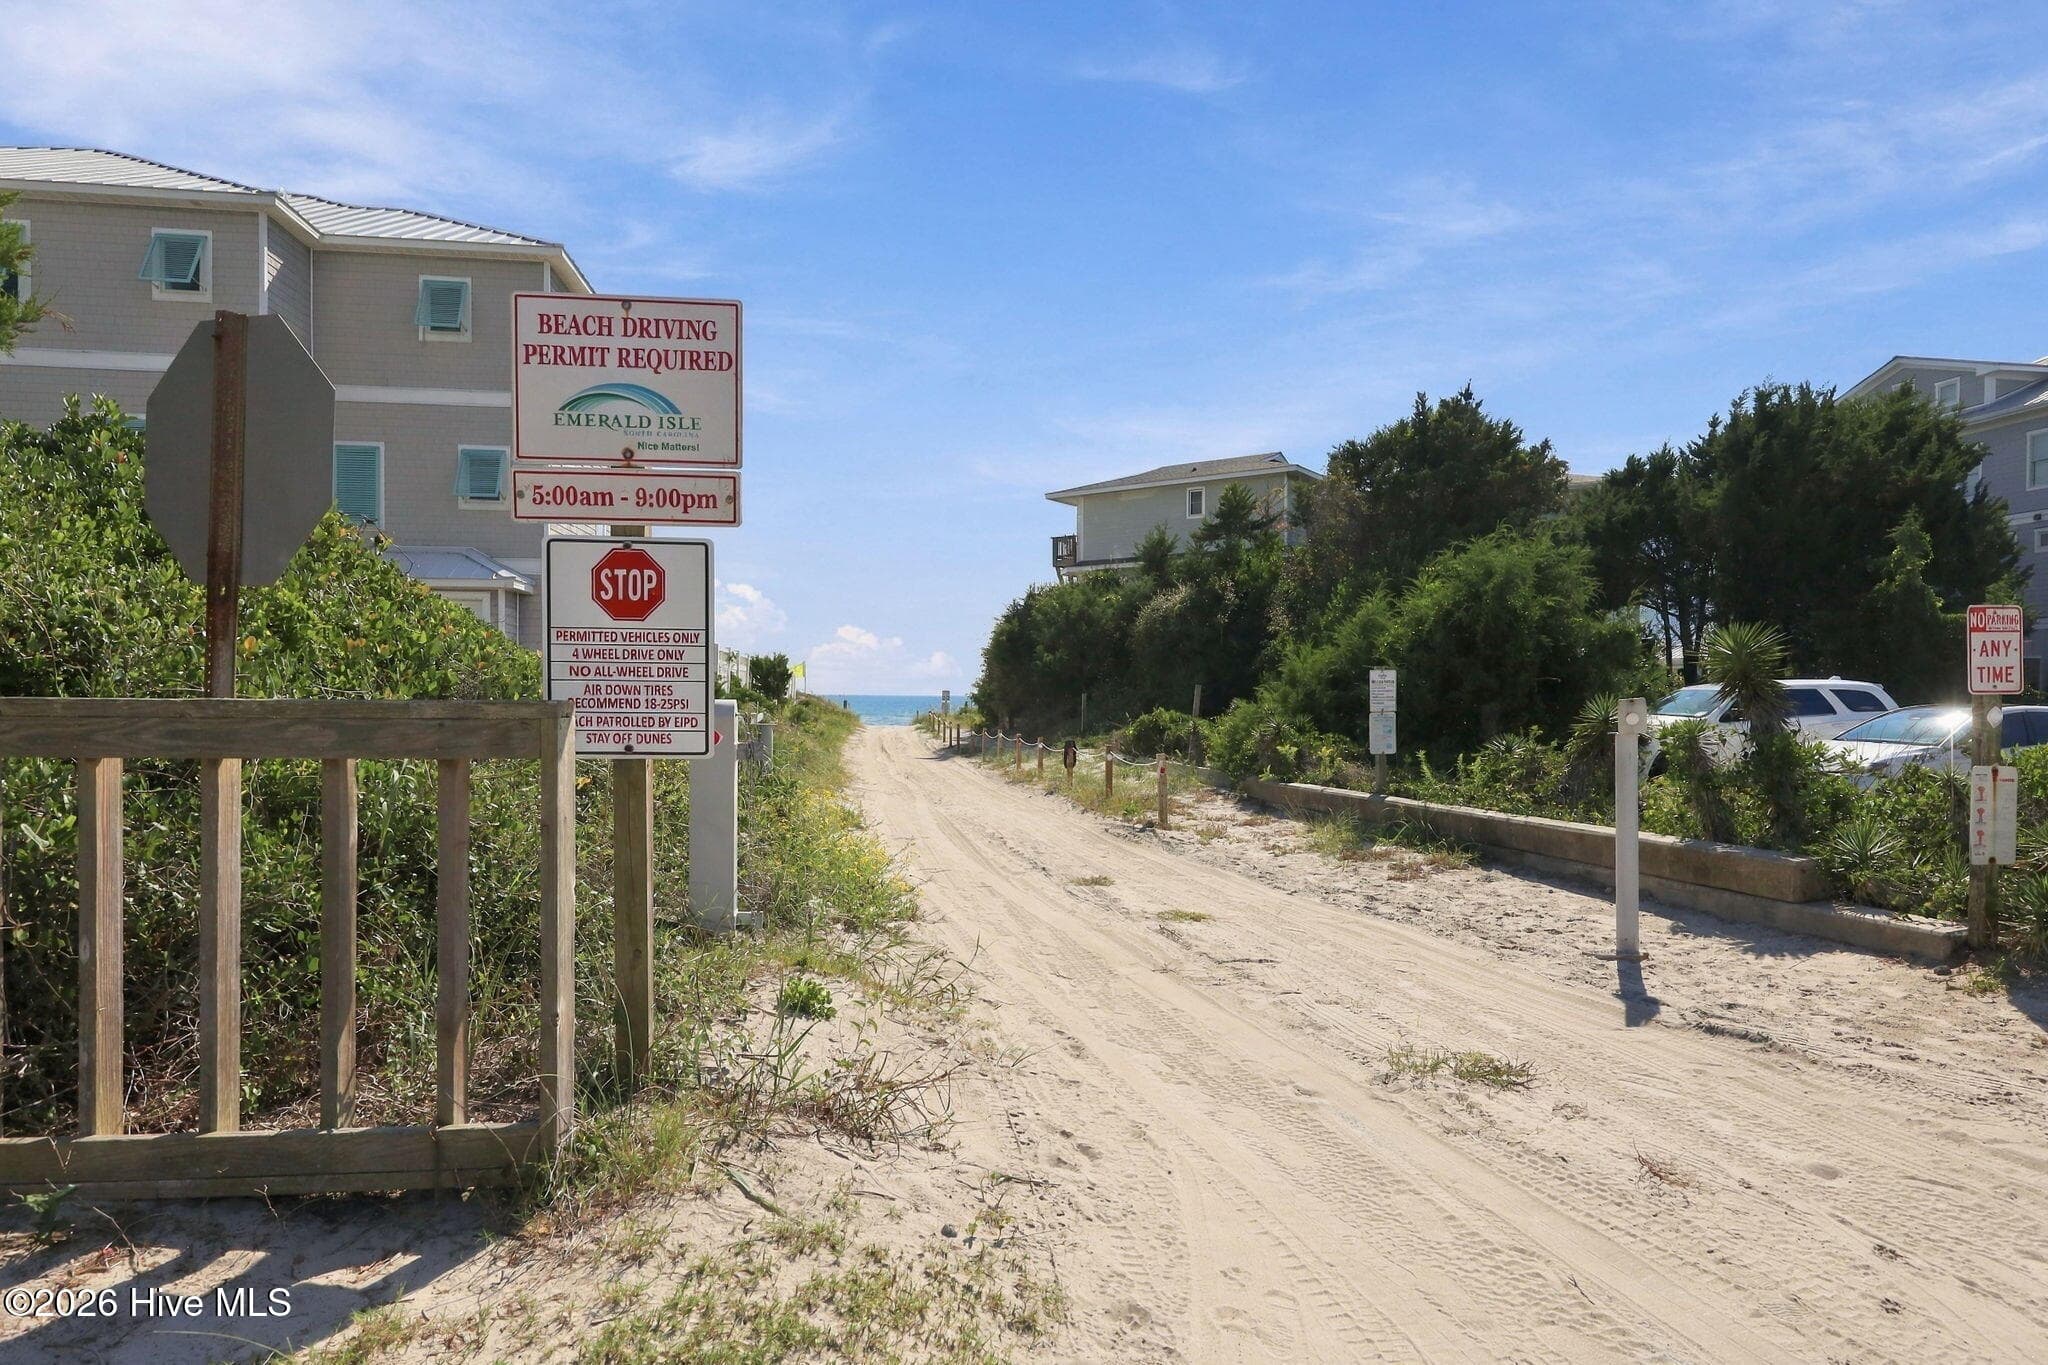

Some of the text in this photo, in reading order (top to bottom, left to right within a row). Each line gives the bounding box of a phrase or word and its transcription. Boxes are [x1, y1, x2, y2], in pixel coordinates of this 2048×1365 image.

[537, 313, 717, 341] BEACH DRIVING
[523, 344, 733, 374] PERMIT REQUIRED
[553, 412, 702, 431] EMERALD ISLE
[637, 441, 700, 452] Nice Matters!
[532, 485, 614, 507] 5:00am
[635, 488, 718, 513] 9:00pm
[600, 568, 657, 601] STOP
[1970, 612, 2019, 628] NO PARKING
[556, 630, 700, 644] PERMITTED VEHICLES ONLY
[572, 648, 685, 661] 4 WHEEL DRIVE ONLY
[1979, 640, 2012, 657] ANY
[569, 665, 689, 678] NO ALL-WHEEL DRIVE
[1976, 666, 2015, 683] TIME
[584, 684, 673, 696] AIR DOWN TIRES
[568, 697, 689, 710] ECOMMEND 18-25PSI
[596, 716, 655, 728] PATROLLED
[658, 717, 671, 728] BY
[674, 717, 698, 728] EIPD
[586, 733, 672, 744] STAY OFF DUNES
